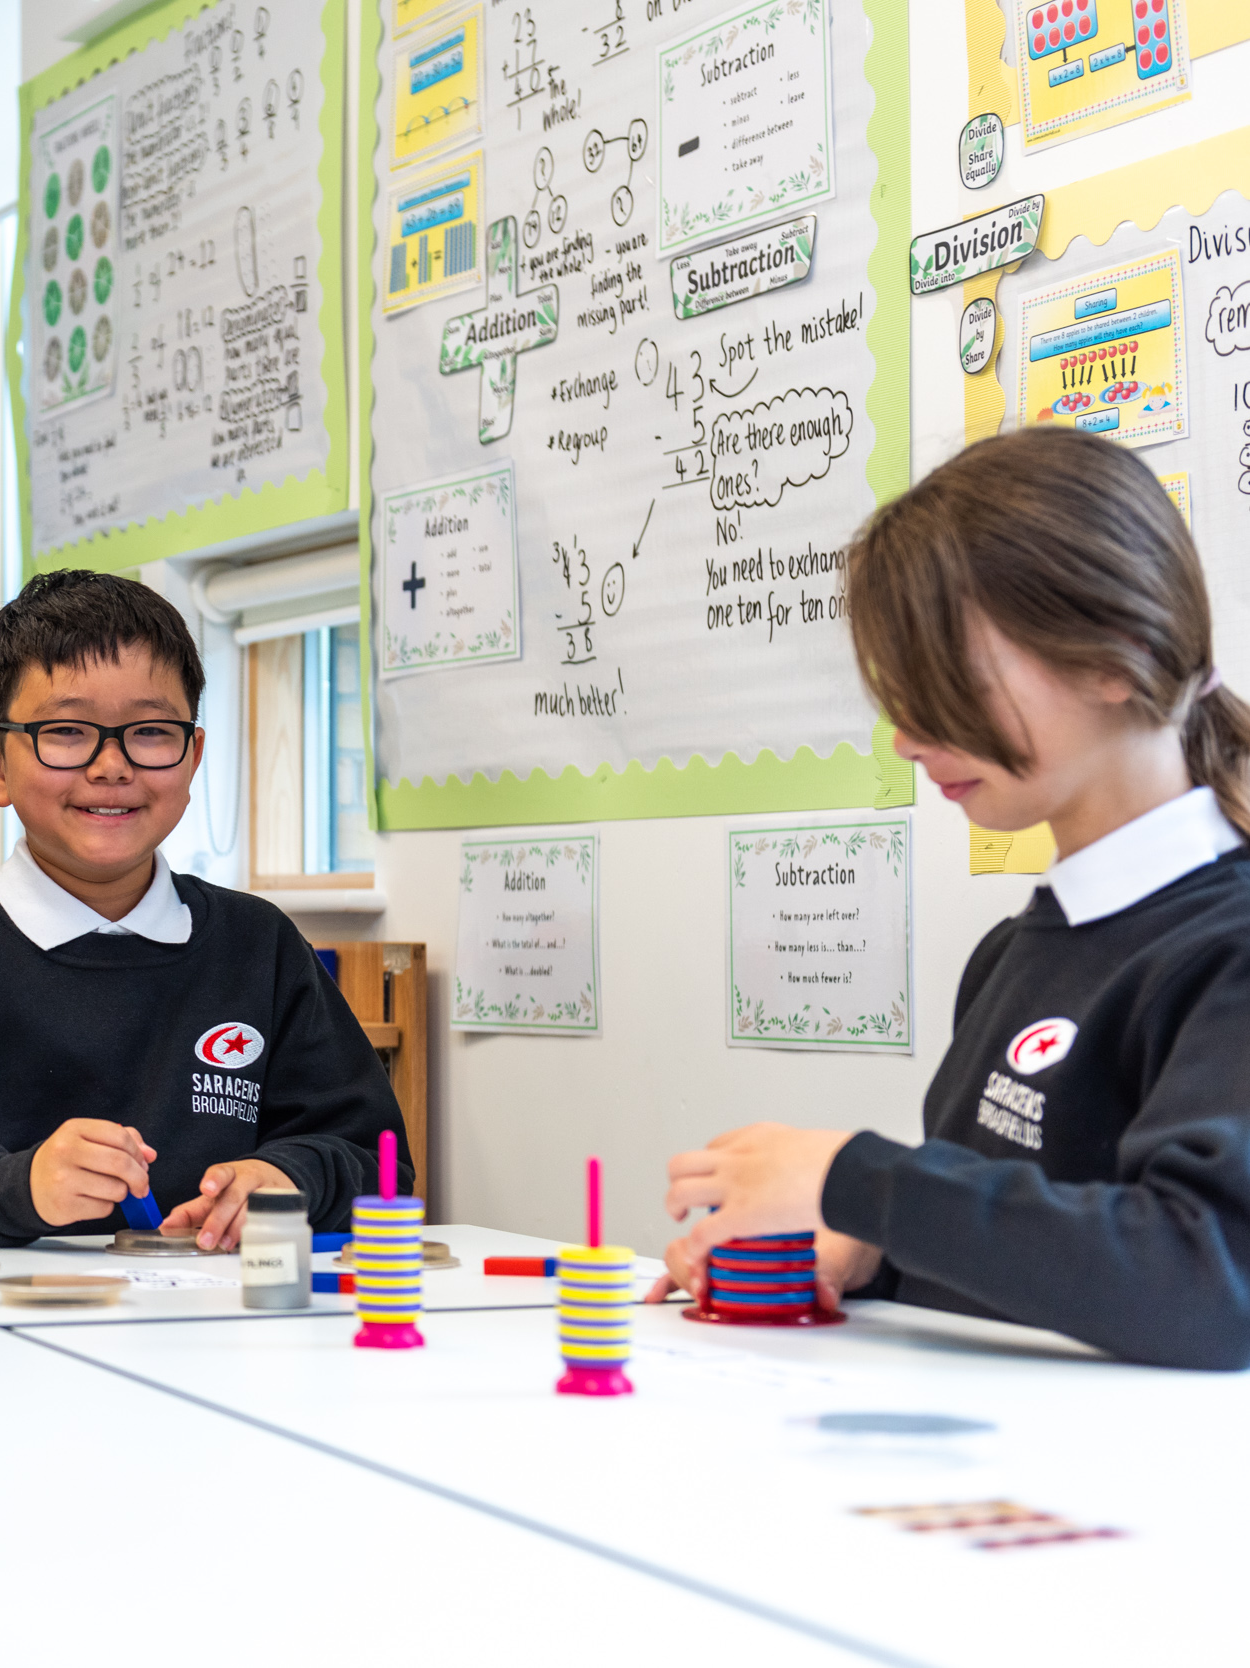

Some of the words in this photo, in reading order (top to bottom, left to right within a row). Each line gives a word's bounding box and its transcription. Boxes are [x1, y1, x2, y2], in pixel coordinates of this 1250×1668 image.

[600, 25, 627, 57] 32
[701, 42, 775, 87] Subtraction
[787, 70, 800, 81] less
[730, 86, 758, 105] subtract
[787, 91, 805, 104] leave
[731, 114, 750, 127] minus
[969, 122, 997, 140] Divide
[731, 130, 766, 150] difference
[767, 119, 794, 136] between
[732, 161, 748, 173] take
[749, 154, 764, 167] away
[969, 149, 993, 165] Share
[966, 161, 997, 181] equally
[1009, 203, 1030, 218] Divide
[1032, 200, 1040, 211] by
[781, 225, 809, 241] Subtract
[725, 247, 740, 258] Take
[741, 242, 758, 253] away
[935, 221, 1022, 271] Division
[1189, 225, 1250, 263] Divis
[676, 261, 690, 271] Less
[688, 243, 796, 295] Subtraction
[591, 268, 624, 300] finding
[626, 261, 643, 283] the
[770, 274, 788, 286] Minus
[915, 275, 939, 290] Divide
[941, 272, 955, 283] into
[695, 293, 725, 310] Difference
[725, 286, 749, 300] between
[1085, 299, 1107, 310] Sharing
[577, 302, 617, 335] missing
[619, 284, 650, 326] part!
[969, 307, 992, 324] Divide
[465, 308, 537, 346] Addition
[719, 332, 755, 377] Spot
[763, 320, 793, 355] the
[801, 291, 863, 344] mistake!
[1094, 321, 1109, 331] shared
[1111, 316, 1131, 325] between
[976, 329, 984, 342] by
[965, 351, 985, 365] Share
[666, 351, 705, 411] 43
[692, 405, 706, 445] 5
[717, 429, 742, 456] Are
[745, 422, 786, 450] there
[790, 407, 843, 456] enough
[717, 459, 760, 500] ones?
[425, 514, 469, 538] Addition
[717, 509, 744, 546] No!
[706, 558, 727, 596] You
[733, 548, 763, 582] need
[769, 547, 785, 580] to
[789, 542, 848, 594] exchang
[707, 604, 734, 630] one
[737, 595, 762, 625] ten
[767, 591, 792, 643] for
[800, 590, 824, 623] ten
[534, 682, 575, 717] much
[577, 667, 627, 717] better!
[504, 869, 546, 891] Addition
[775, 862, 855, 886] Subtraction
[780, 910, 791, 921] How
[794, 913, 810, 926] many
[813, 913, 824, 921] are
[826, 909, 839, 920] left
[841, 908, 859, 920] over?
[492, 938, 506, 949] What
[512, 938, 520, 948] the
[521, 938, 533, 949] total
[775, 941, 786, 952] How
[789, 943, 805, 957] many
[807, 940, 819, 952] less
[505, 965, 518, 976] What
[788, 971, 800, 983] How
[803, 971, 819, 983] much
[821, 971, 841, 983] fewer
[843, 971, 852, 983] is?
[192, 1073, 260, 1102] SARACENS
[192, 1095, 258, 1123] BROADFIELDS
